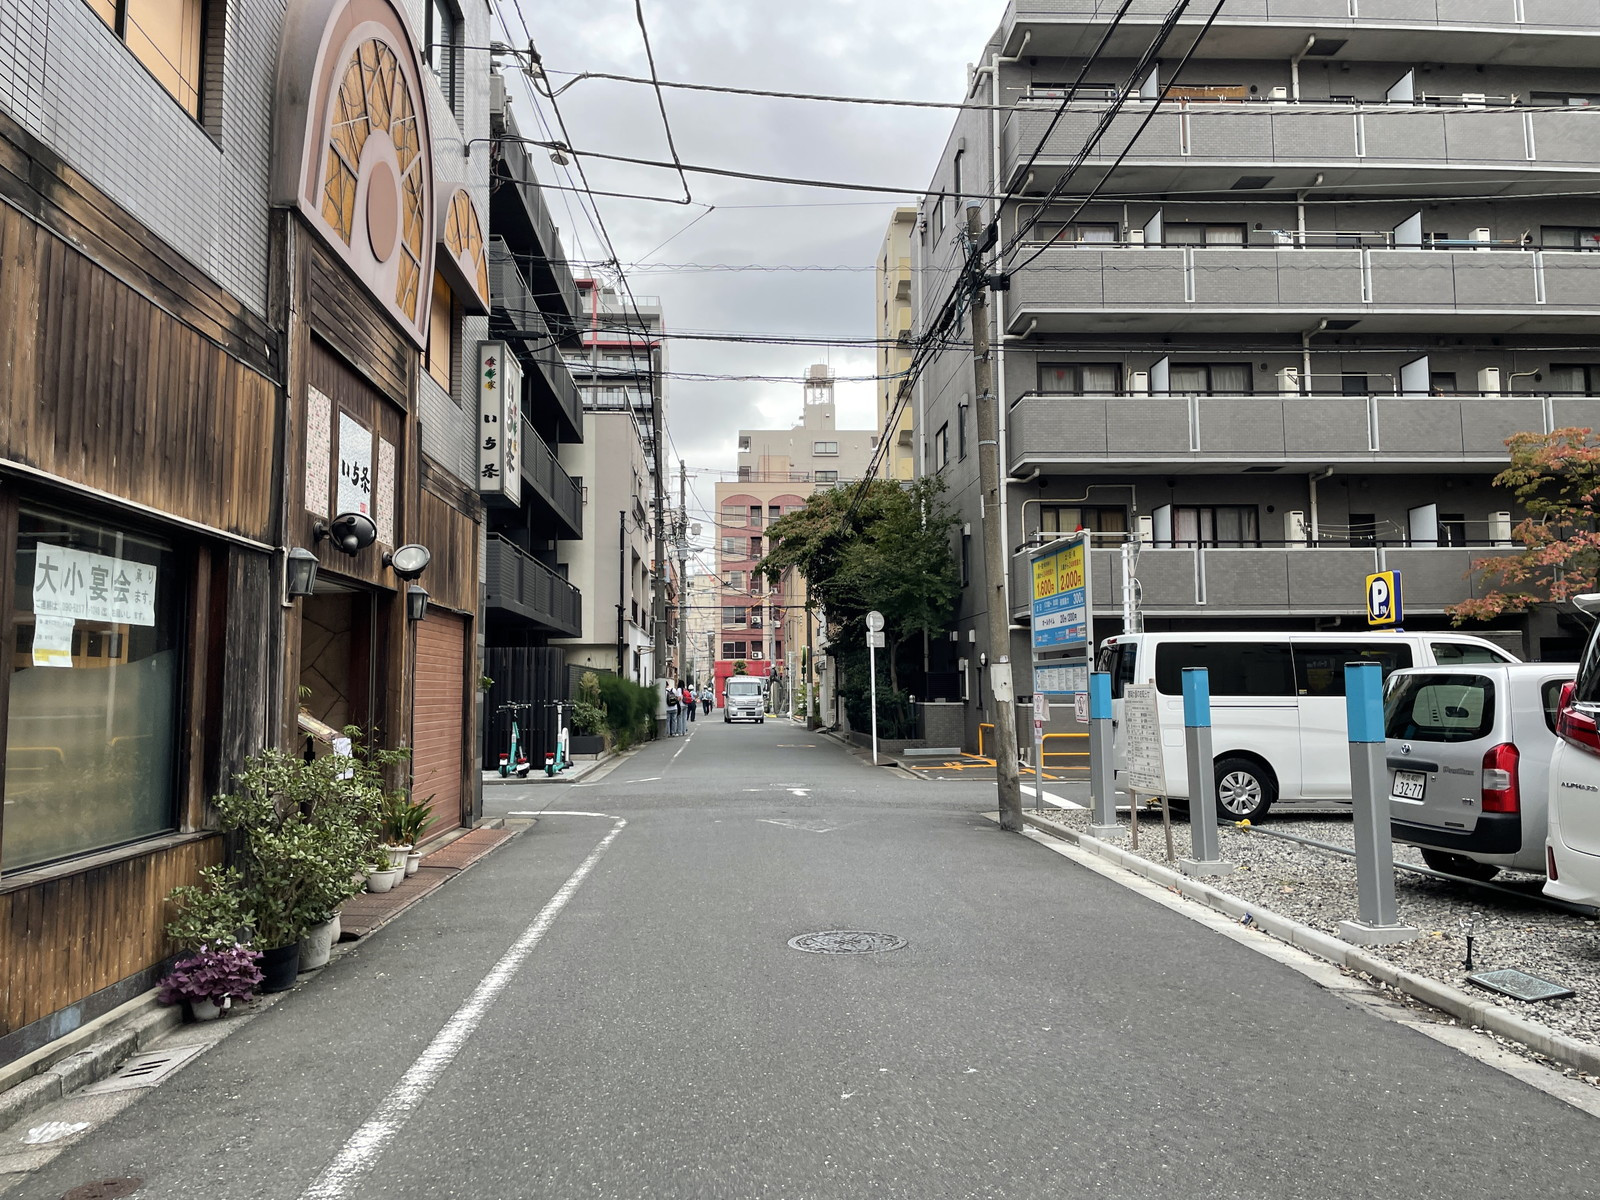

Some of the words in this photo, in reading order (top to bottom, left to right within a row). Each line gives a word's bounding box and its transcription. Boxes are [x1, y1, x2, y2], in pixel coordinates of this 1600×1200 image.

[481, 414, 500, 479] いち条
[342, 459, 371, 494] いち条
[36, 555, 131, 604] 大小宴会
[1372, 580, 1388, 616] P
[1399, 781, 1423, 798] 32-77
